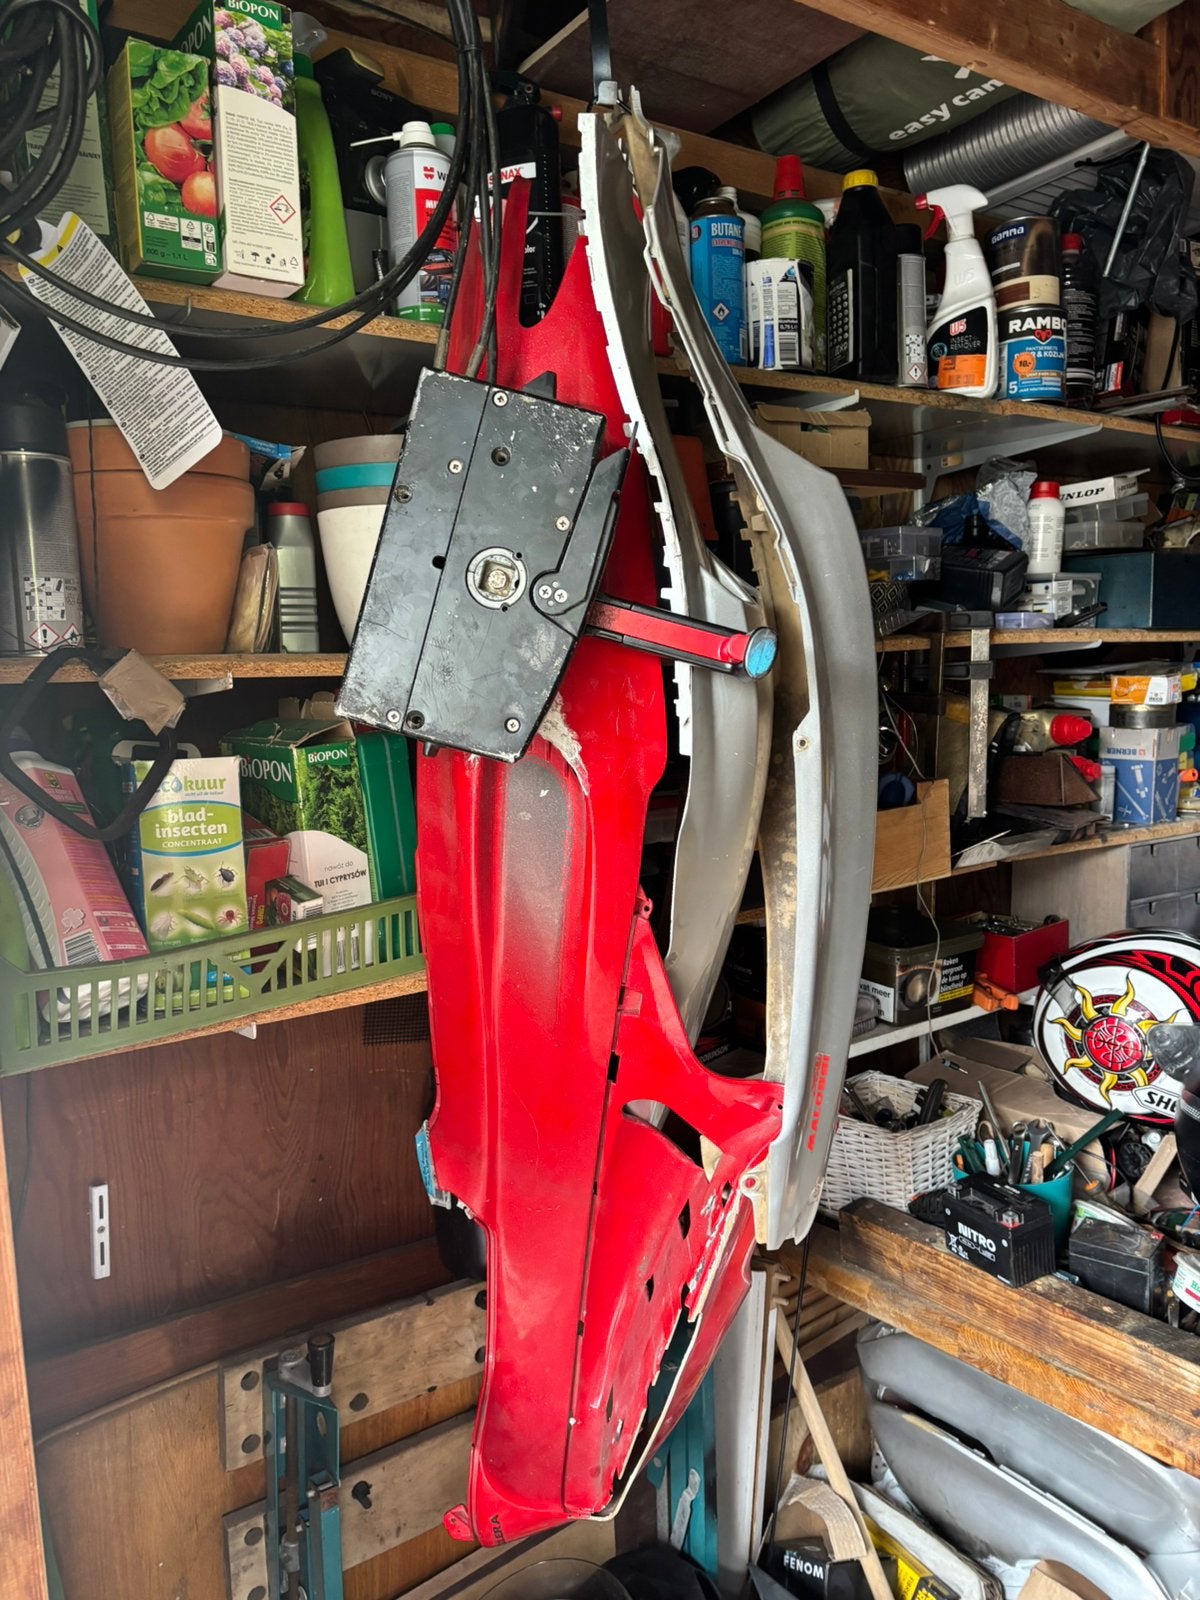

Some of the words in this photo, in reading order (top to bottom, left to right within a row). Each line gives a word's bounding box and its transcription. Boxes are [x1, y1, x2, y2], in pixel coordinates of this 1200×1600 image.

[888, 102, 951, 140] easy
[488, 167, 522, 185] SNAX
[711, 222, 742, 239] BUTANE
[949, 319, 967, 336] W5
[1008, 381, 1018, 394] 5
[167, 806, 214, 823] blad-
[155, 823, 228, 838] insecten
[161, 837, 223, 848] CONCENTRAAT
[330, 869, 367, 885] CYPRYSÓW
[871, 987, 891, 998] meer
[957, 1221, 997, 1253] NITRO
[783, 1554, 824, 1580] FENOM
